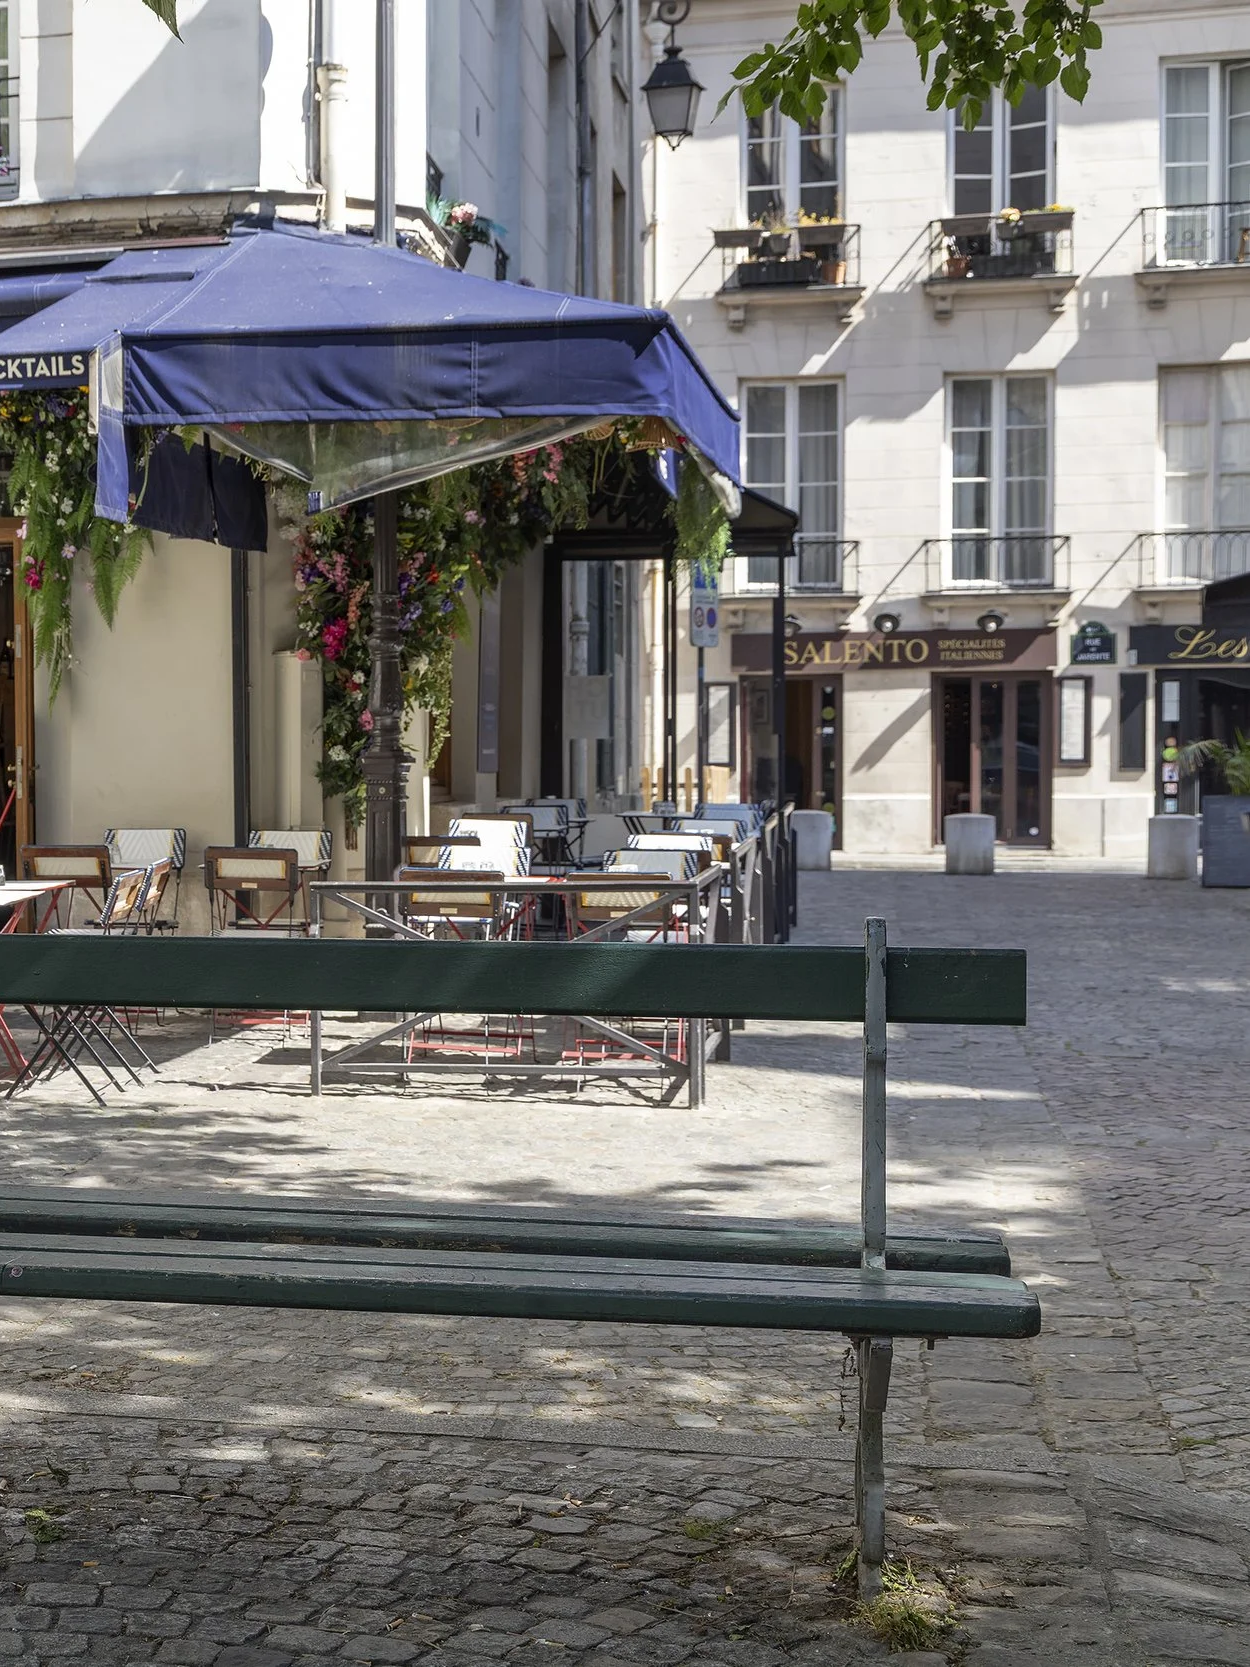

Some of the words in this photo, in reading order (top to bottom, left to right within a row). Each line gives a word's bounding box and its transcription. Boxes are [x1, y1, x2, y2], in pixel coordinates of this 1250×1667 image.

[784, 639, 929, 665] SALENTO
[1085, 638, 1101, 646] RUE
[1167, 625, 1250, 660] Les
